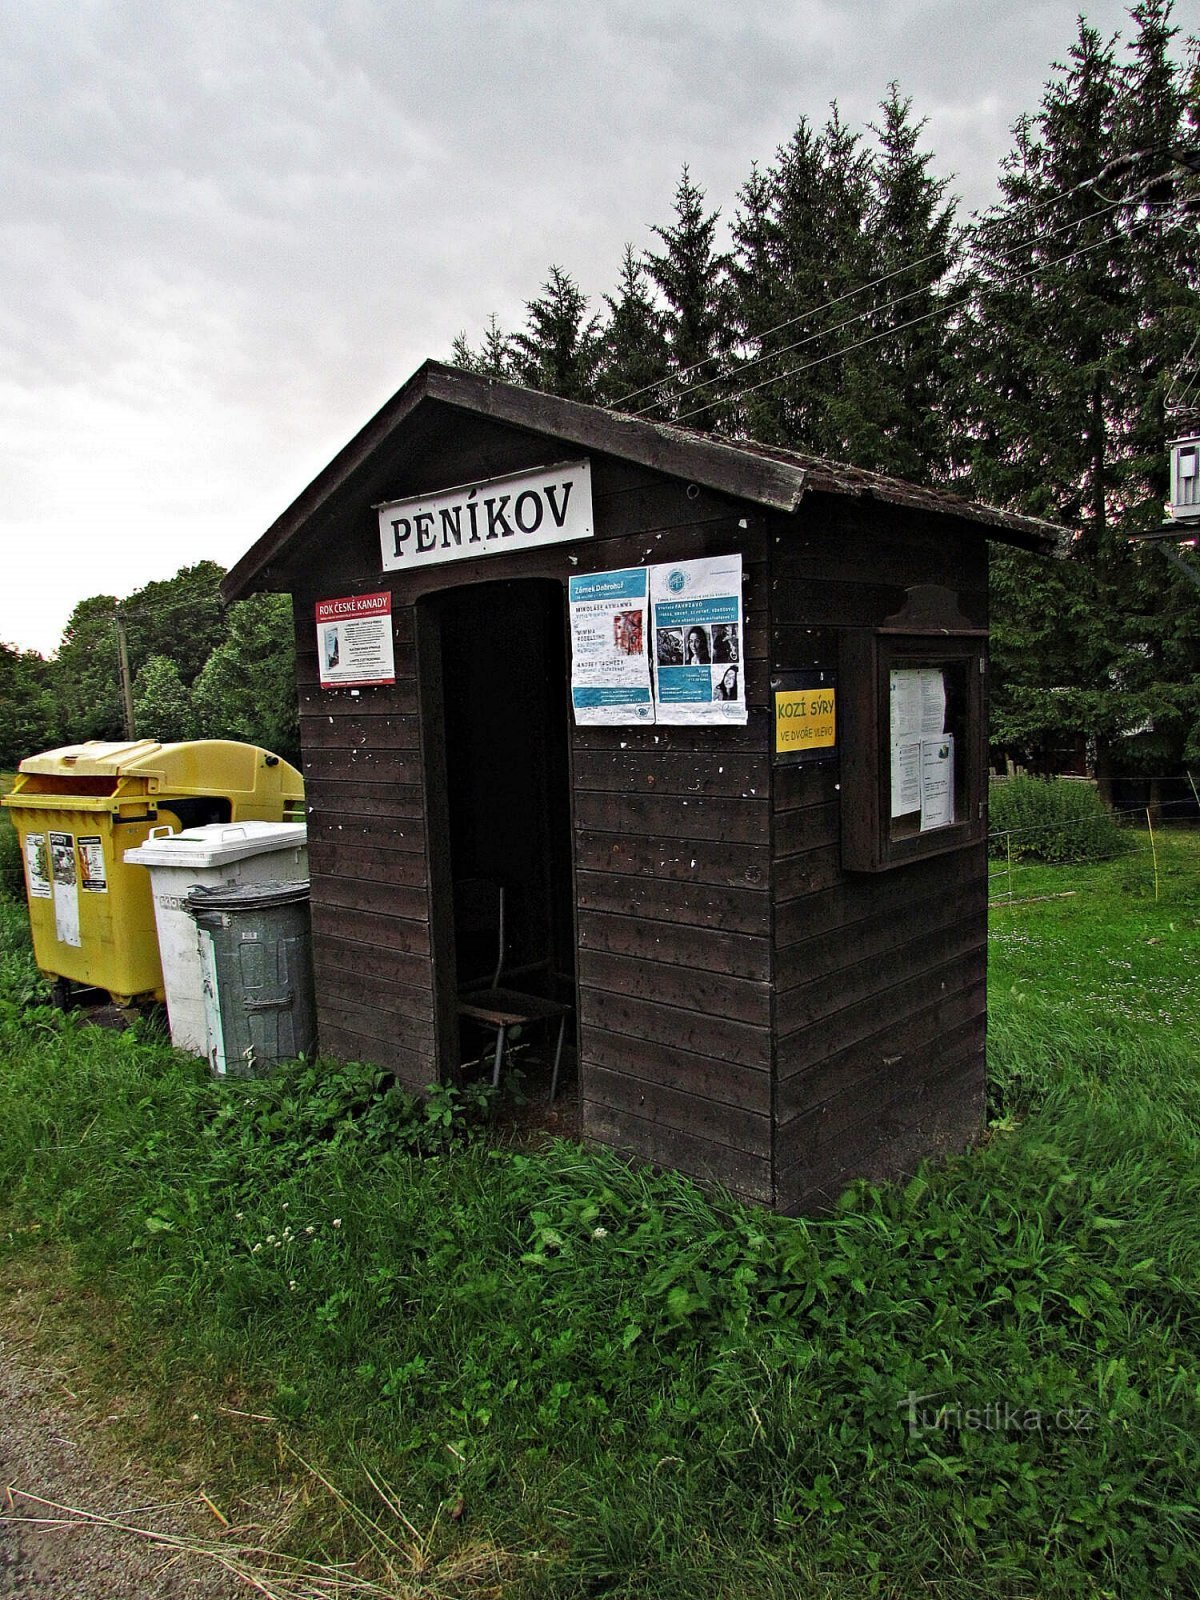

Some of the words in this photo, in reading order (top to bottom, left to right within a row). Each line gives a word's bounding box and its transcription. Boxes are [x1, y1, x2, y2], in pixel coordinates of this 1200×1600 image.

[390, 482, 573, 558] PENÍKOV
[319, 604, 334, 615] ROK
[334, 599, 357, 613] ČESKÉ
[357, 597, 388, 610] KANADY
[778, 697, 807, 719] KOZÍ
[810, 695, 834, 716] SÝRY
[780, 730, 790, 742] VE
